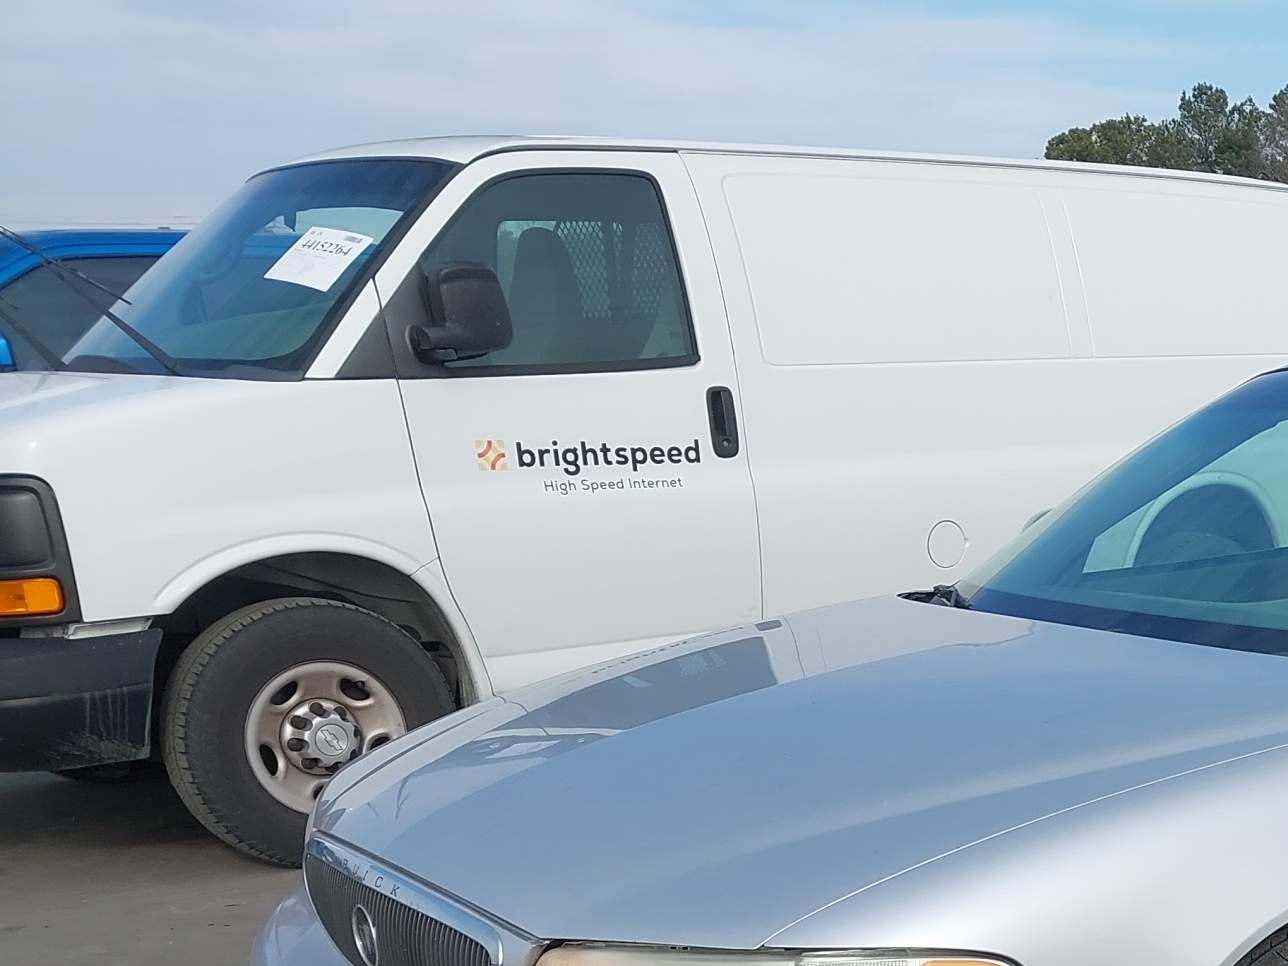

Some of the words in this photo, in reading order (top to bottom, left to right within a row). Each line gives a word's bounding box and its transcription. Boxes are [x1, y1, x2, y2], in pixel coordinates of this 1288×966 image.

[515, 439, 702, 476] brightspeed
[544, 480, 577, 496] High
[580, 478, 625, 494] Speed
[628, 477, 684, 490] Internet
